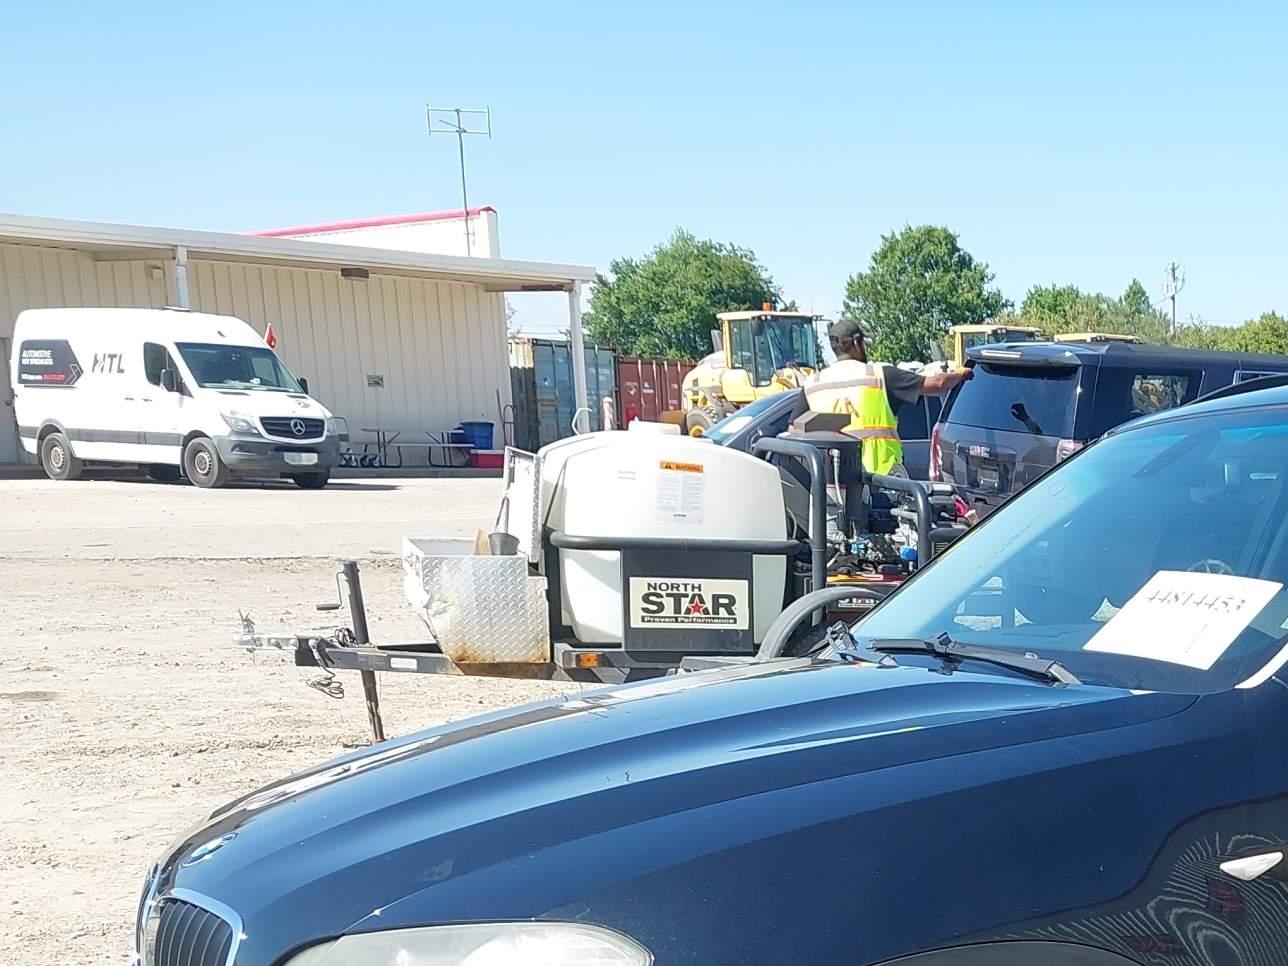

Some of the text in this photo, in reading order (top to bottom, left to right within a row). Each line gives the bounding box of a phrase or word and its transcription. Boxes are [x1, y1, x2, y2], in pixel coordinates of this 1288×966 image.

[675, 464, 701, 472] WARNING
[647, 582, 702, 593] NORTH
[641, 592, 737, 616] STAR
[677, 616, 735, 624] Performance
